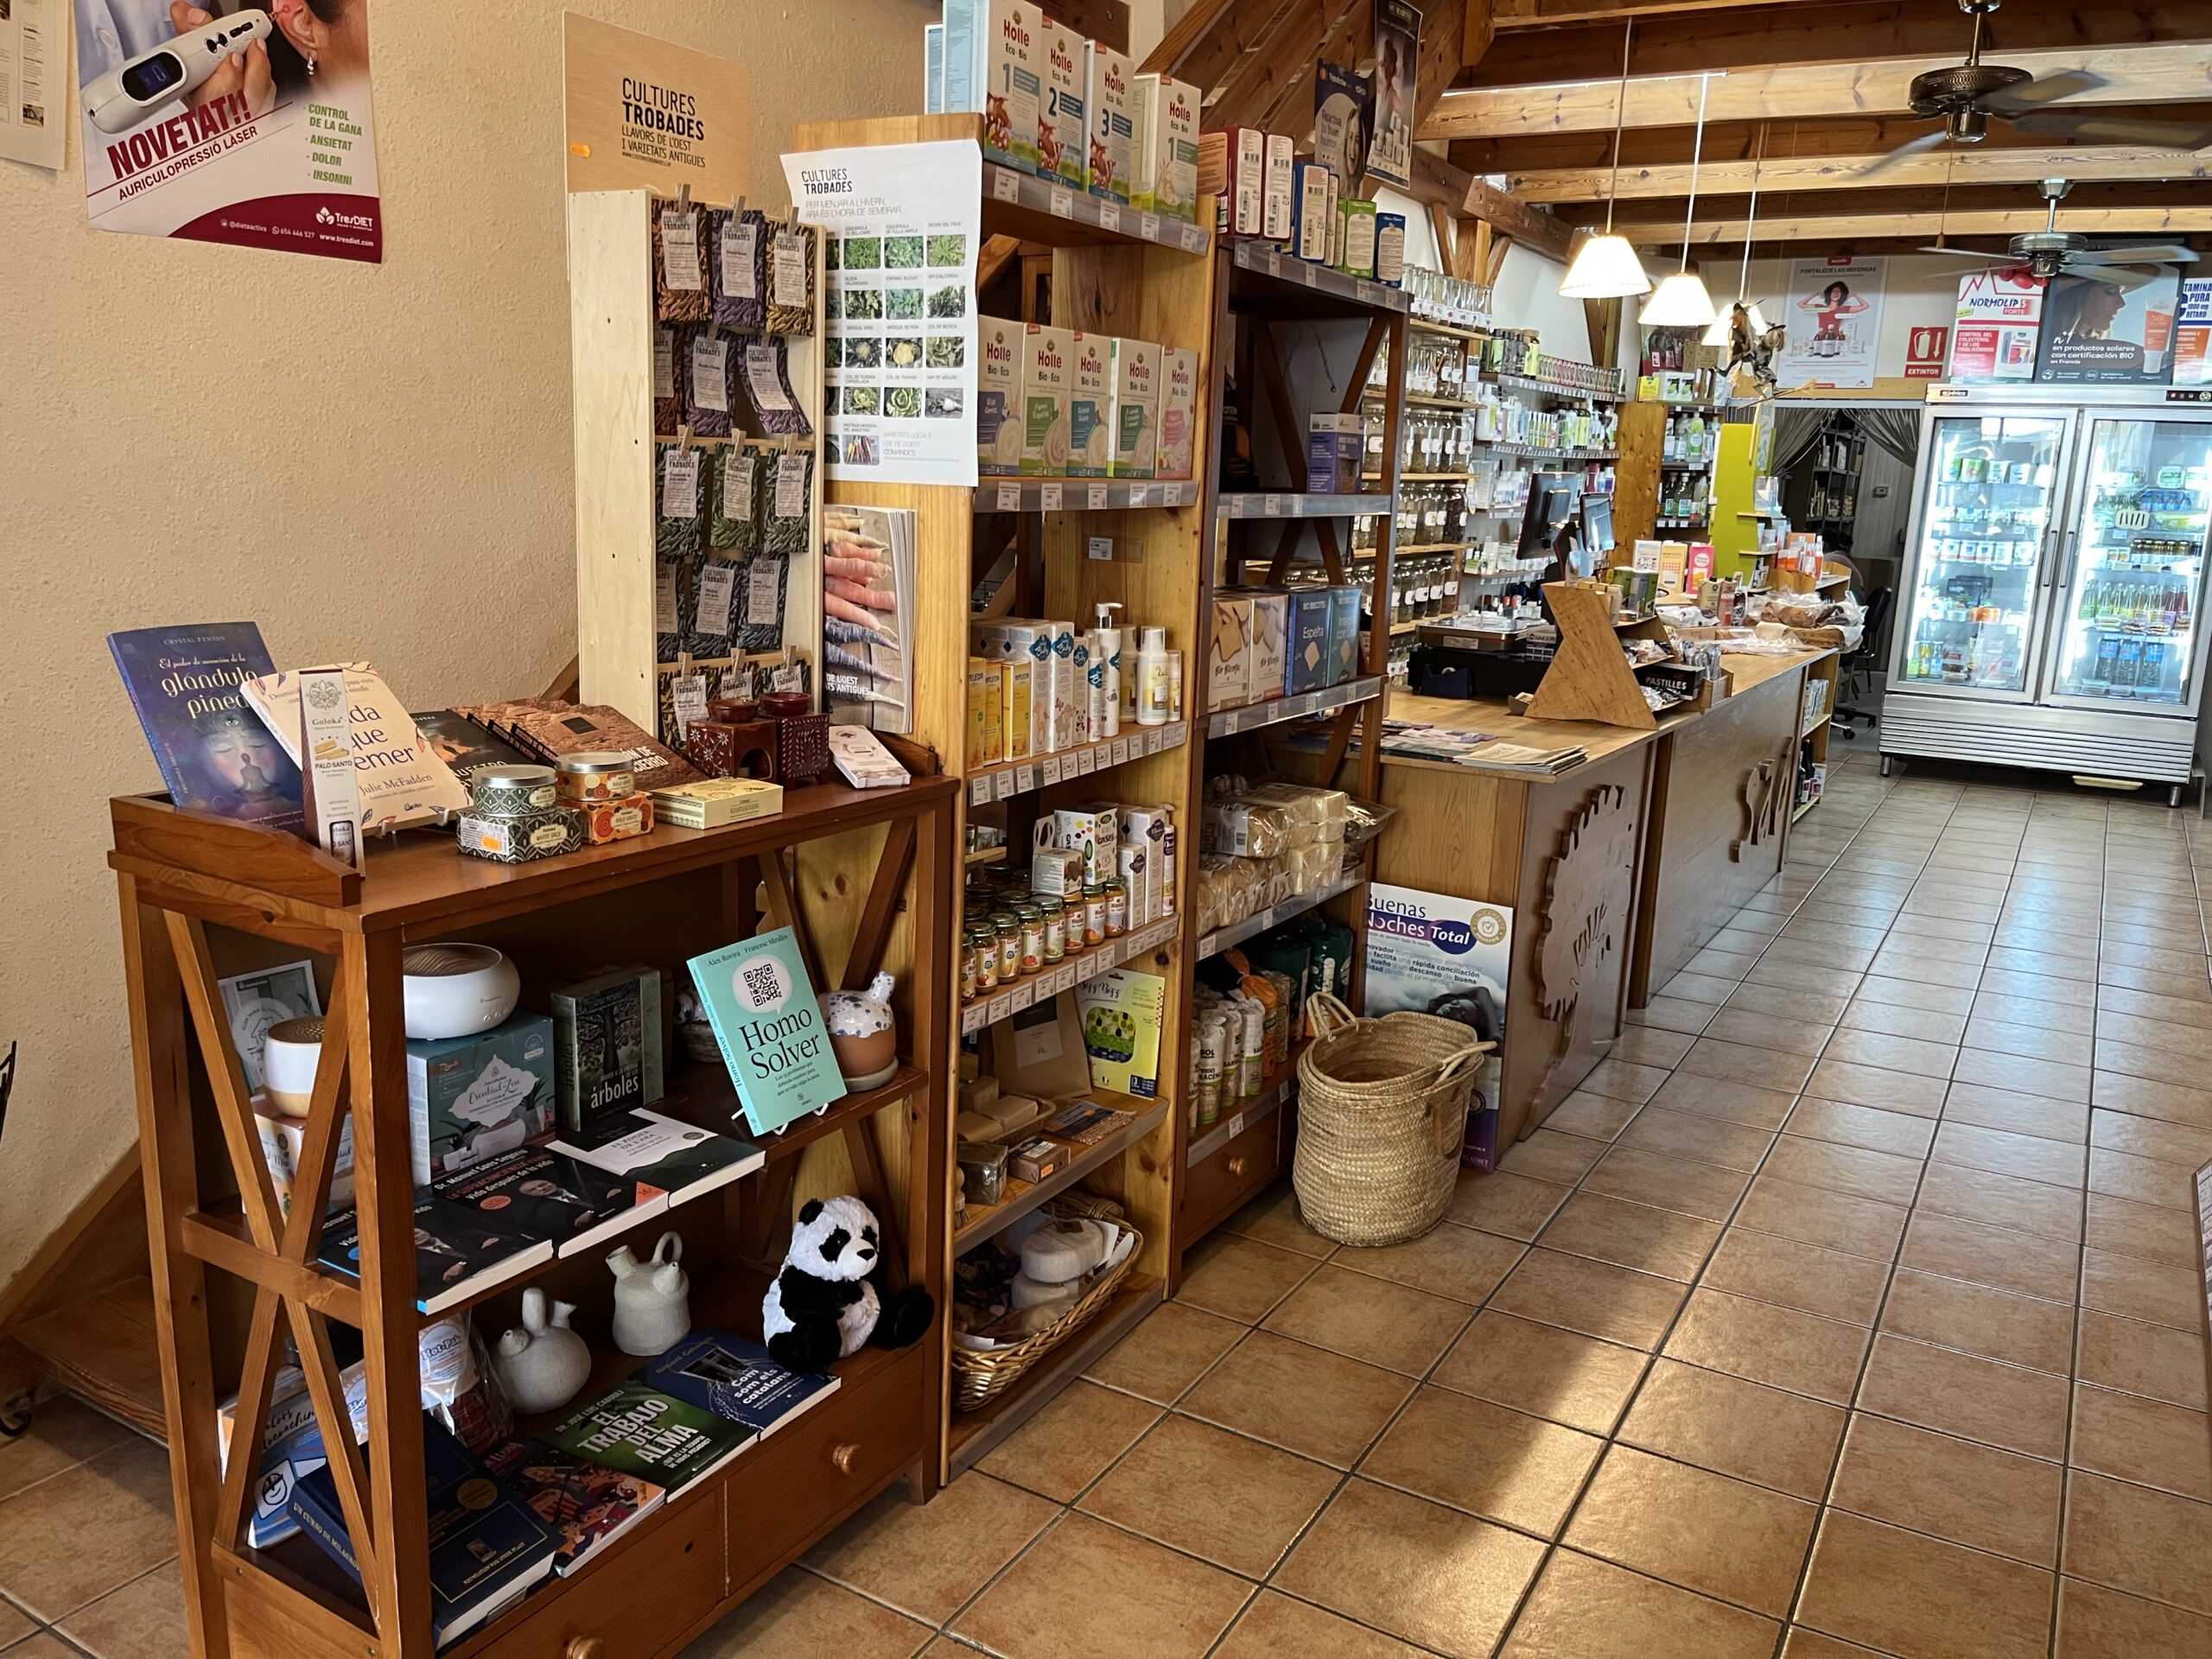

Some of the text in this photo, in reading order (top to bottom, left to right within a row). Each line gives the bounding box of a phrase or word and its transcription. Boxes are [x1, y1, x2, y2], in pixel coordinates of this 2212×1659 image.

[1004, 18, 1030, 48] Holle
[1005, 43, 1027, 61] Eco Bio
[1050, 47, 1072, 73] Holle
[1003, 63, 1011, 93] 1
[1052, 70, 1061, 82] Eco
[1104, 71, 1125, 95] Holle
[622, 77, 696, 117] CULTURES
[1049, 87, 1058, 118] 2
[1106, 92, 1115, 103] Eco
[308, 104, 349, 121] CONTROL
[622, 100, 704, 141] TROBADES
[1169, 101, 1191, 122] Holle
[309, 117, 363, 137] DE LA GANA
[1102, 108, 1110, 137] 3
[1170, 120, 1189, 134] Eco Bio
[107, 89, 251, 180] NOVETAT!!
[310, 135, 353, 151] ANSIETAT
[622, 124, 692, 152] LLAVORS DE L'OEST
[628, 140, 667, 160] VARIETATS
[669, 149, 706, 168] ANTIGUES
[1167, 137, 1174, 162] 1
[118, 125, 258, 200] AURICULOPRESSIÓ LÀSER
[312, 153, 342, 167] DOLOR
[313, 170, 353, 186] INSOMNI
[802, 168, 848, 182] CULTURES
[804, 181, 852, 195] TROBADES
[335, 213, 372, 227] TresDIET
[2183, 283, 2212, 292] TAMINA
[2190, 293, 2210, 302] PURA
[1969, 298, 2018, 308] NORMOLIP
[987, 343, 1011, 362] Holle
[1038, 350, 1062, 369] Holle
[988, 365, 1010, 377] Bio Eco
[1081, 357, 1102, 374] Holle
[1129, 363, 1150, 379] Holle
[1039, 372, 1060, 384] Bio Eco
[1303, 626, 1324, 639] Espelta
[826, 674, 858, 685] DE L'OEST
[837, 683, 871, 696] ANTIGUES
[1645, 677, 1687, 690] PASTILLES
[188, 694, 251, 719] pinea
[312, 717, 342, 727] Goloka
[315, 761, 332, 770] PALO
[355, 745, 415, 771] emer
[359, 784, 382, 796] Julie
[384, 774, 433, 790] McFadden
[1431, 925, 1470, 945] Total
[721, 950, 741, 962] Rovira
[744, 942, 768, 954] Francesc
[1370, 958, 1391, 967] sueño
[1408, 966, 1442, 977] descanso
[1454, 975, 1478, 985] buena
[1373, 951, 1397, 962] facilita
[1412, 959, 1435, 970] rápida
[1437, 963, 1480, 978] conciliación
[738, 1008, 812, 1052] Homo
[750, 1034, 821, 1079] Solver
[590, 1075, 639, 1109] árboles
[435, 1180, 447, 1191] Dr.
[446, 1168, 476, 1185] Manuel
[465, 1188, 485, 1200] Vida
[485, 1176, 518, 1192] después
[421, 1334, 461, 1361] Hot-Pak
[731, 1368, 760, 1388] Com
[734, 1368, 779, 1399] som els
[742, 1370, 792, 1405] catalans
[576, 1399, 669, 1453] TRABAJO
[591, 1411, 621, 1426] EL
[625, 1426, 665, 1446] DEL
[635, 1424, 698, 1464] ALMA
[294, 1503, 303, 1516] UN
[303, 1511, 323, 1534] CURSO
[322, 1529, 332, 1541] DE
